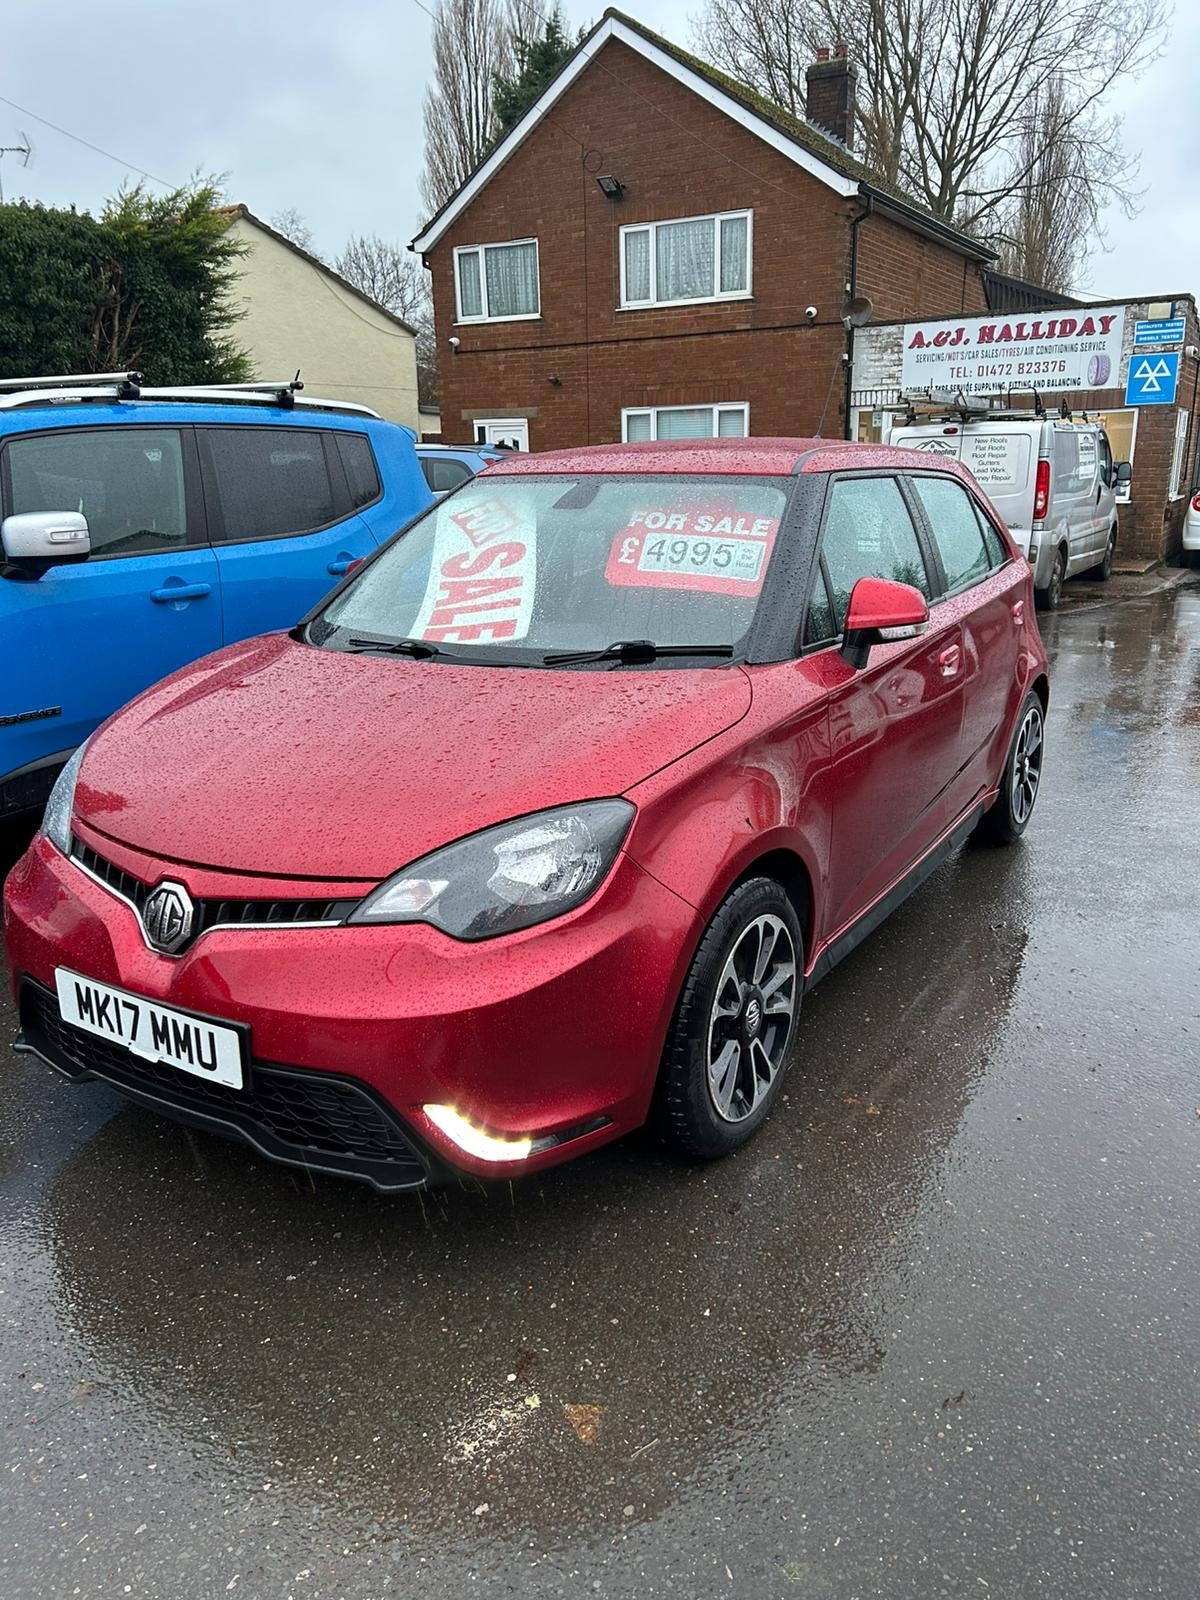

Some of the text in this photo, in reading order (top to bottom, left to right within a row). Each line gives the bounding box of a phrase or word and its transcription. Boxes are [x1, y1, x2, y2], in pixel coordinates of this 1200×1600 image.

[977, 315, 1118, 344] HALLIDAY
[1036, 343, 1079, 355] CONDITIONING
[1080, 341, 1107, 352] SERVICE
[950, 360, 1066, 378] TEL: 01472 823376
[1033, 379, 1046, 387] AND
[1046, 377, 1081, 387] BALANCING
[988, 452, 1007, 460] Repair
[627, 510, 773, 537] FOR SALE
[646, 539, 734, 568] 4995
[735, 560, 755, 569] Road
[422, 541, 527, 643] SALE
[146, 891, 184, 943] MG
[74, 980, 218, 1071] MK17 MMU
